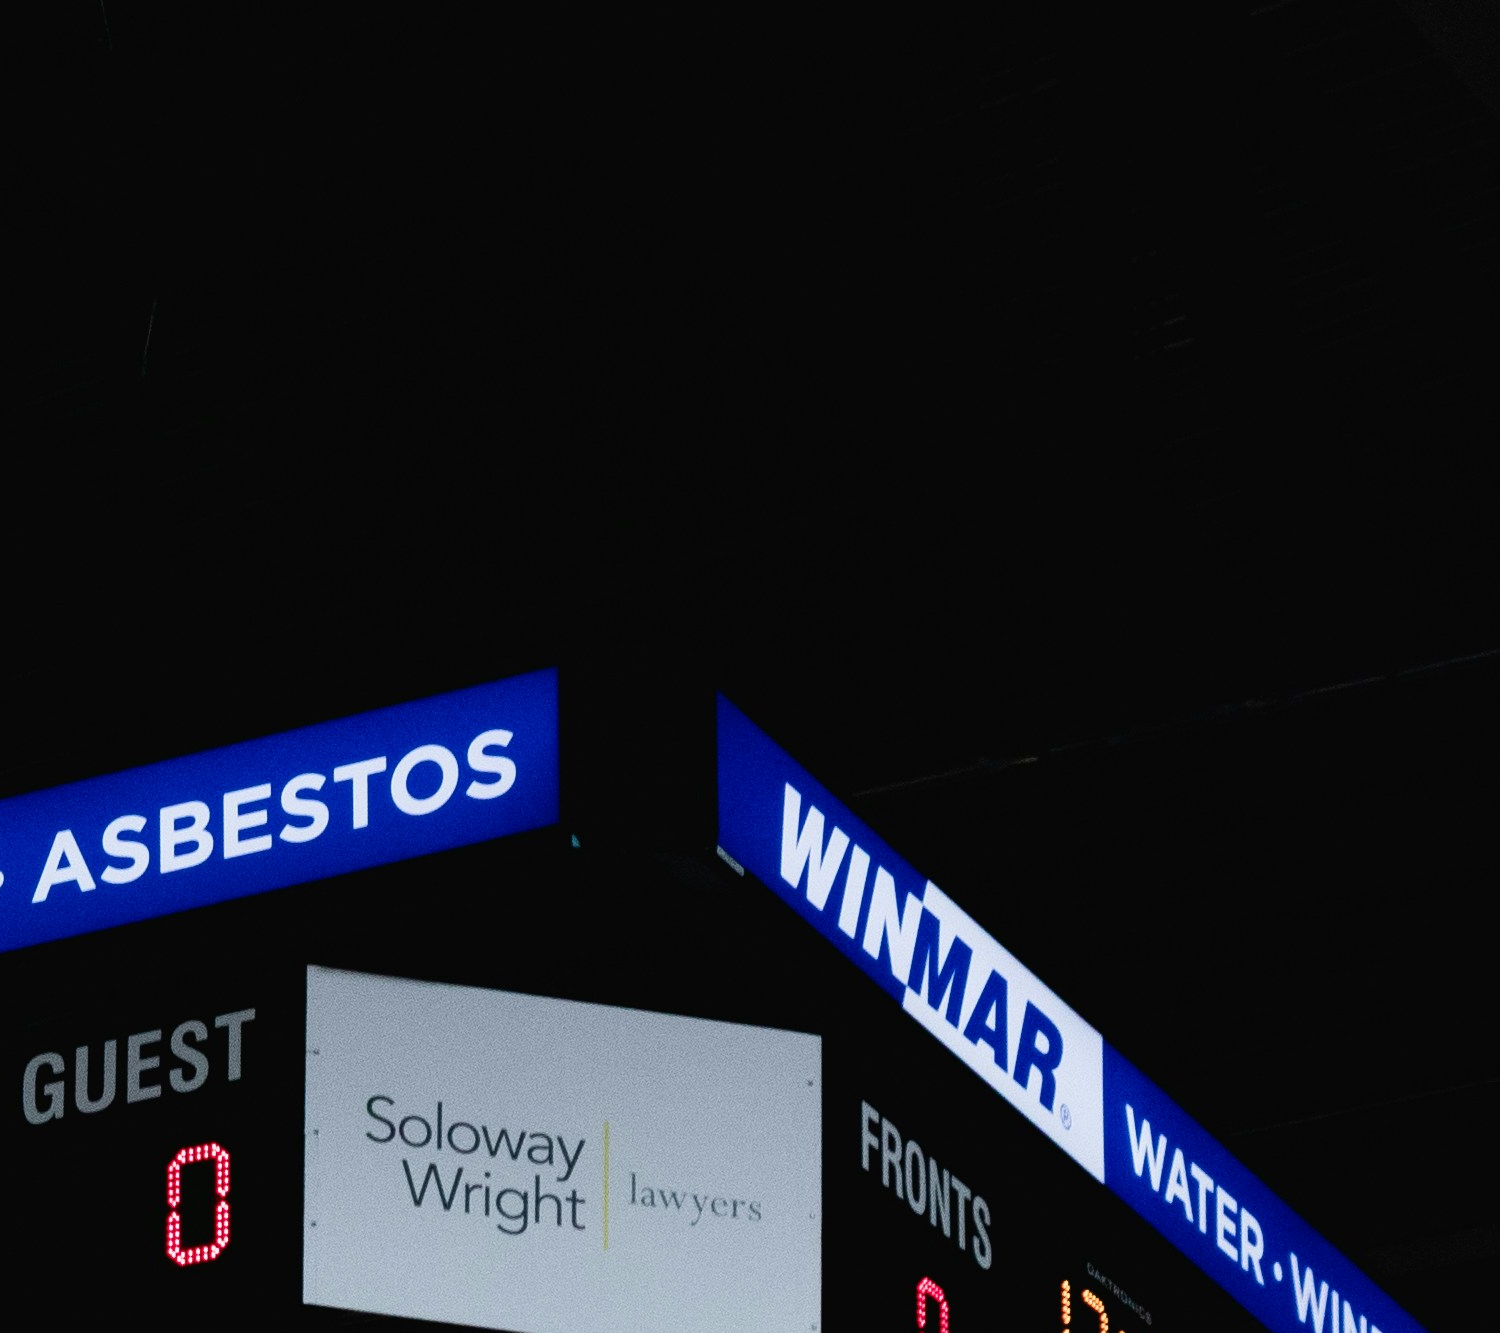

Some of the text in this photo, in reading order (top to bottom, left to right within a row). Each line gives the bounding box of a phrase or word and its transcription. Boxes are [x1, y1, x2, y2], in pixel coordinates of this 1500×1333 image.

[31, 727, 518, 905] ASBESTOS
[21, 1007, 256, 1126] GUEST
[366, 1094, 586, 1183] Soloway
[401, 1159, 763, 1235] Wright lawyers
[861, 1100, 992, 1270] FRONTS
[1125, 1103, 1265, 1285] WATER
[165, 1140, 232, 1267] 0
